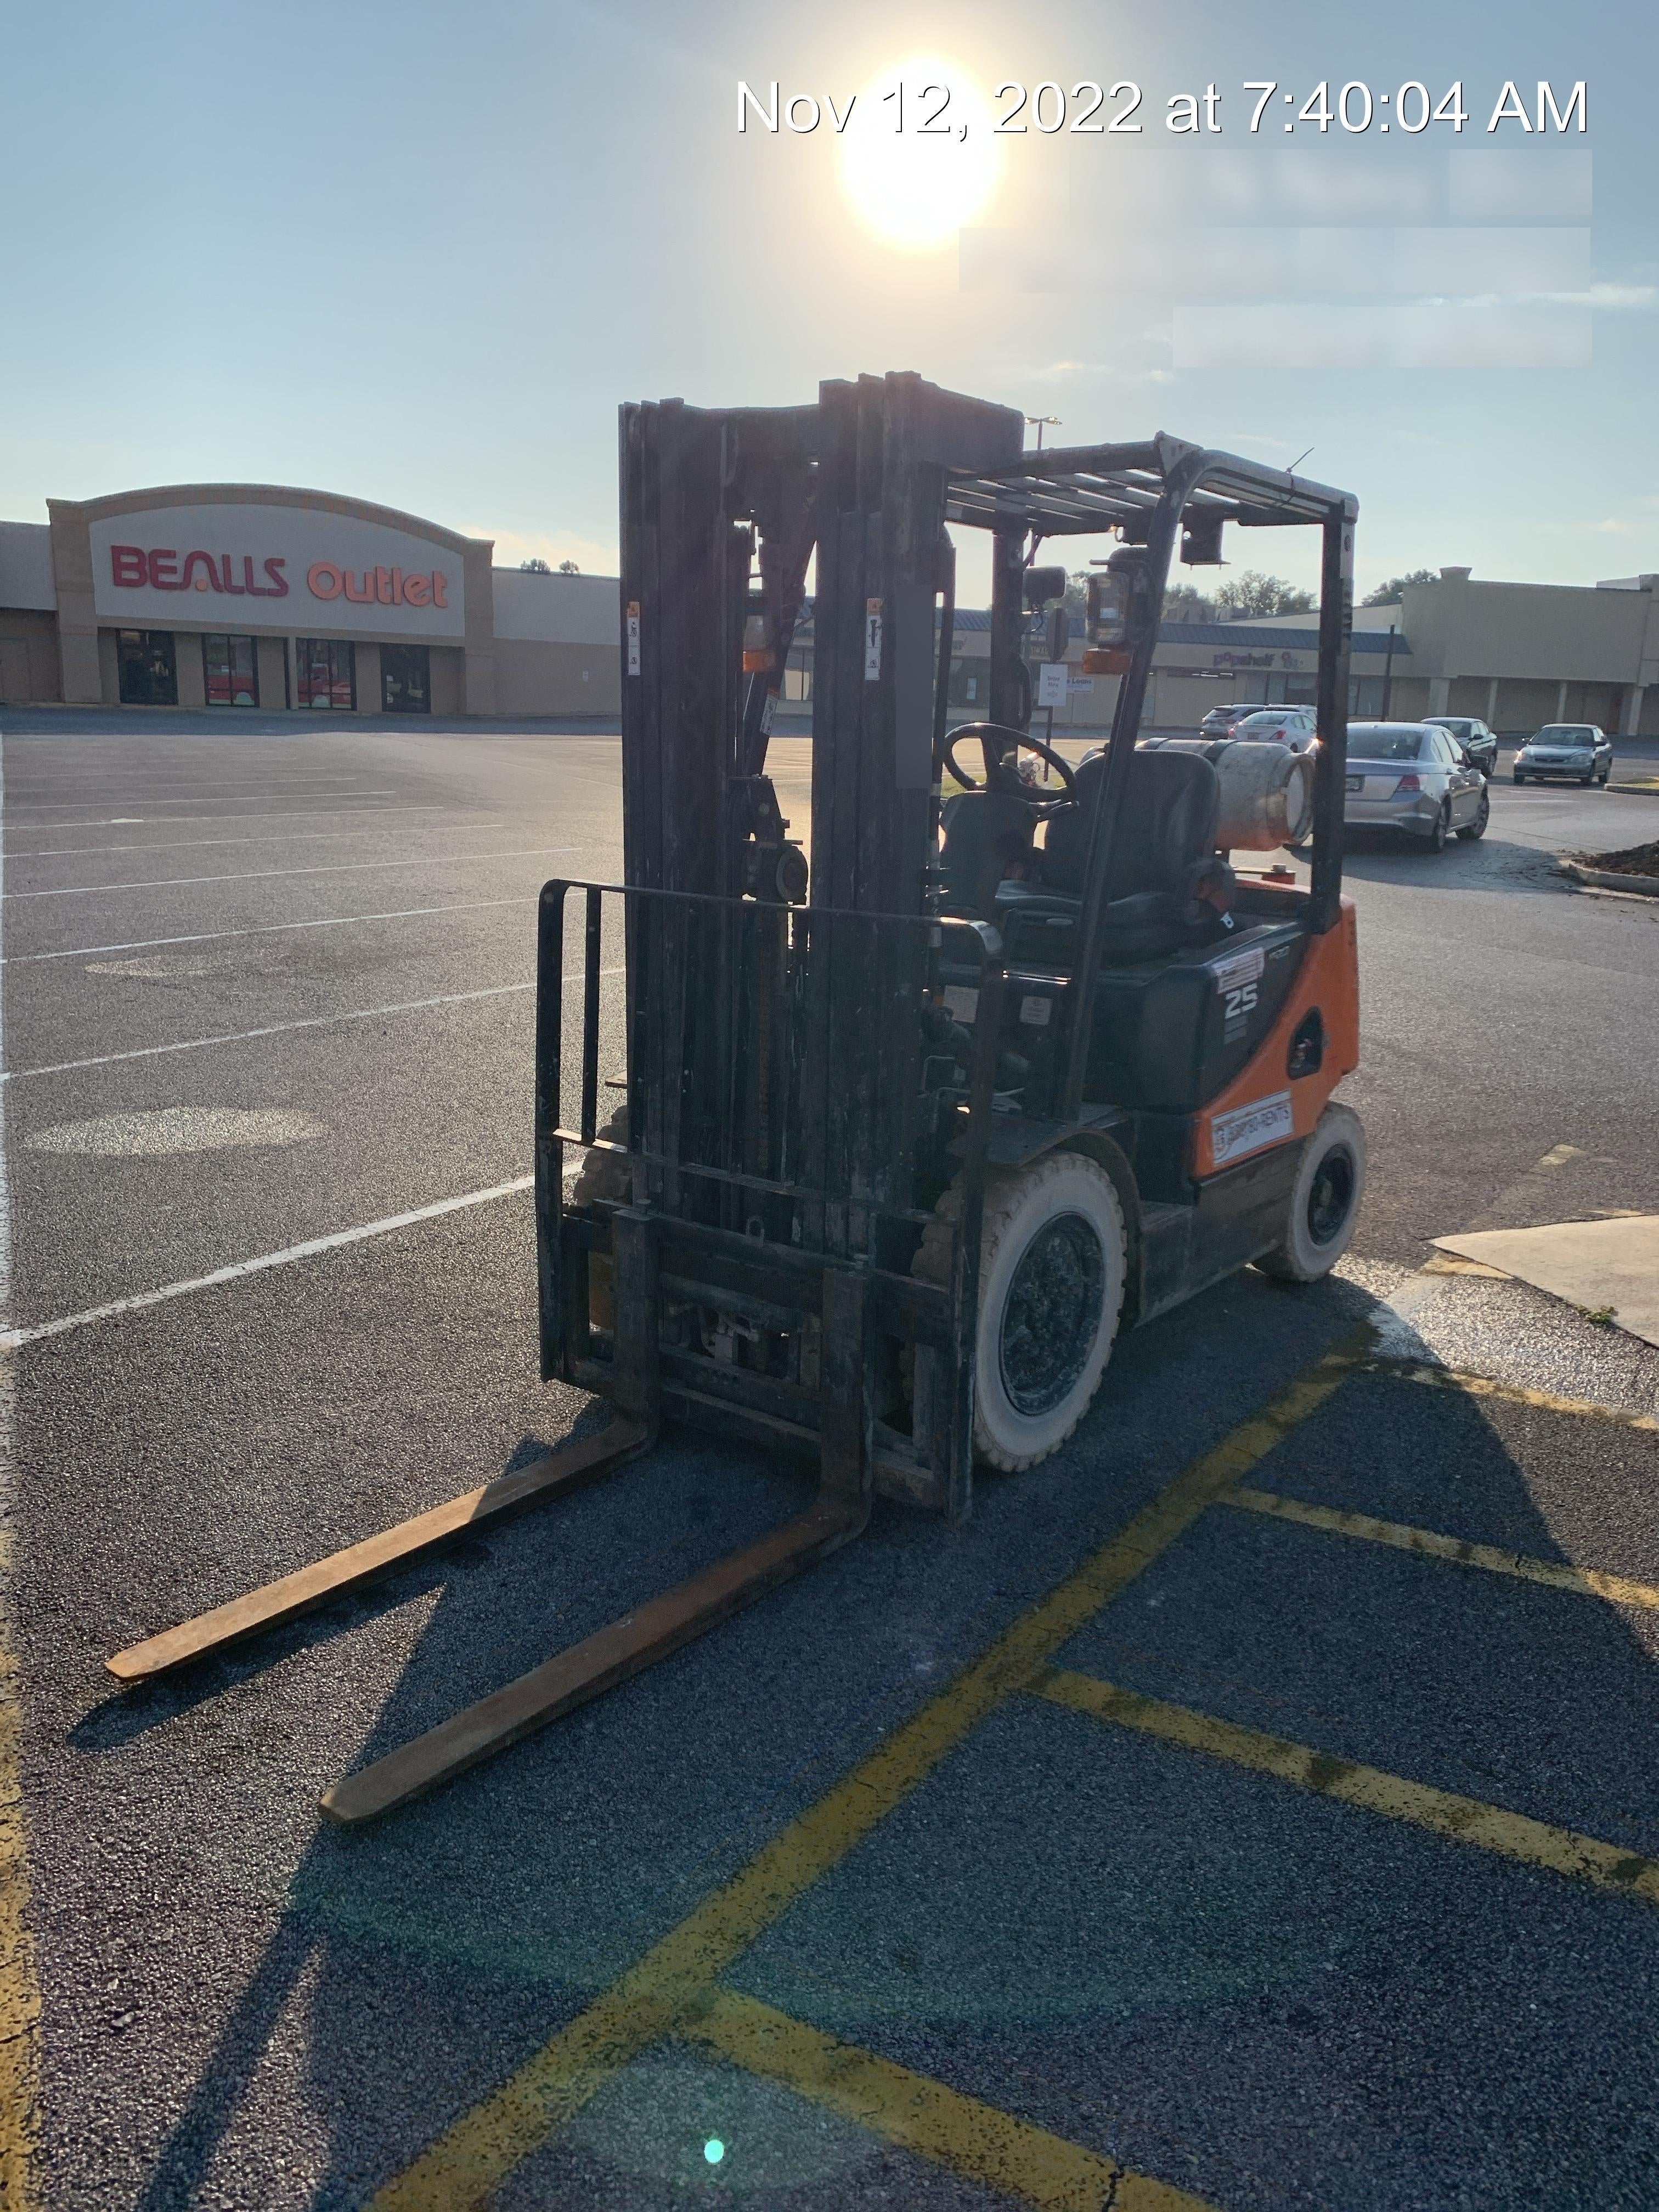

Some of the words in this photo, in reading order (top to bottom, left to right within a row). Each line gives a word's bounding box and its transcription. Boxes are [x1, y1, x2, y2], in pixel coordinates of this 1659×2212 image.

[111, 545, 289, 597] BEALLS
[307, 561, 448, 607] Outlet
[1225, 983, 1258, 1019] 25
